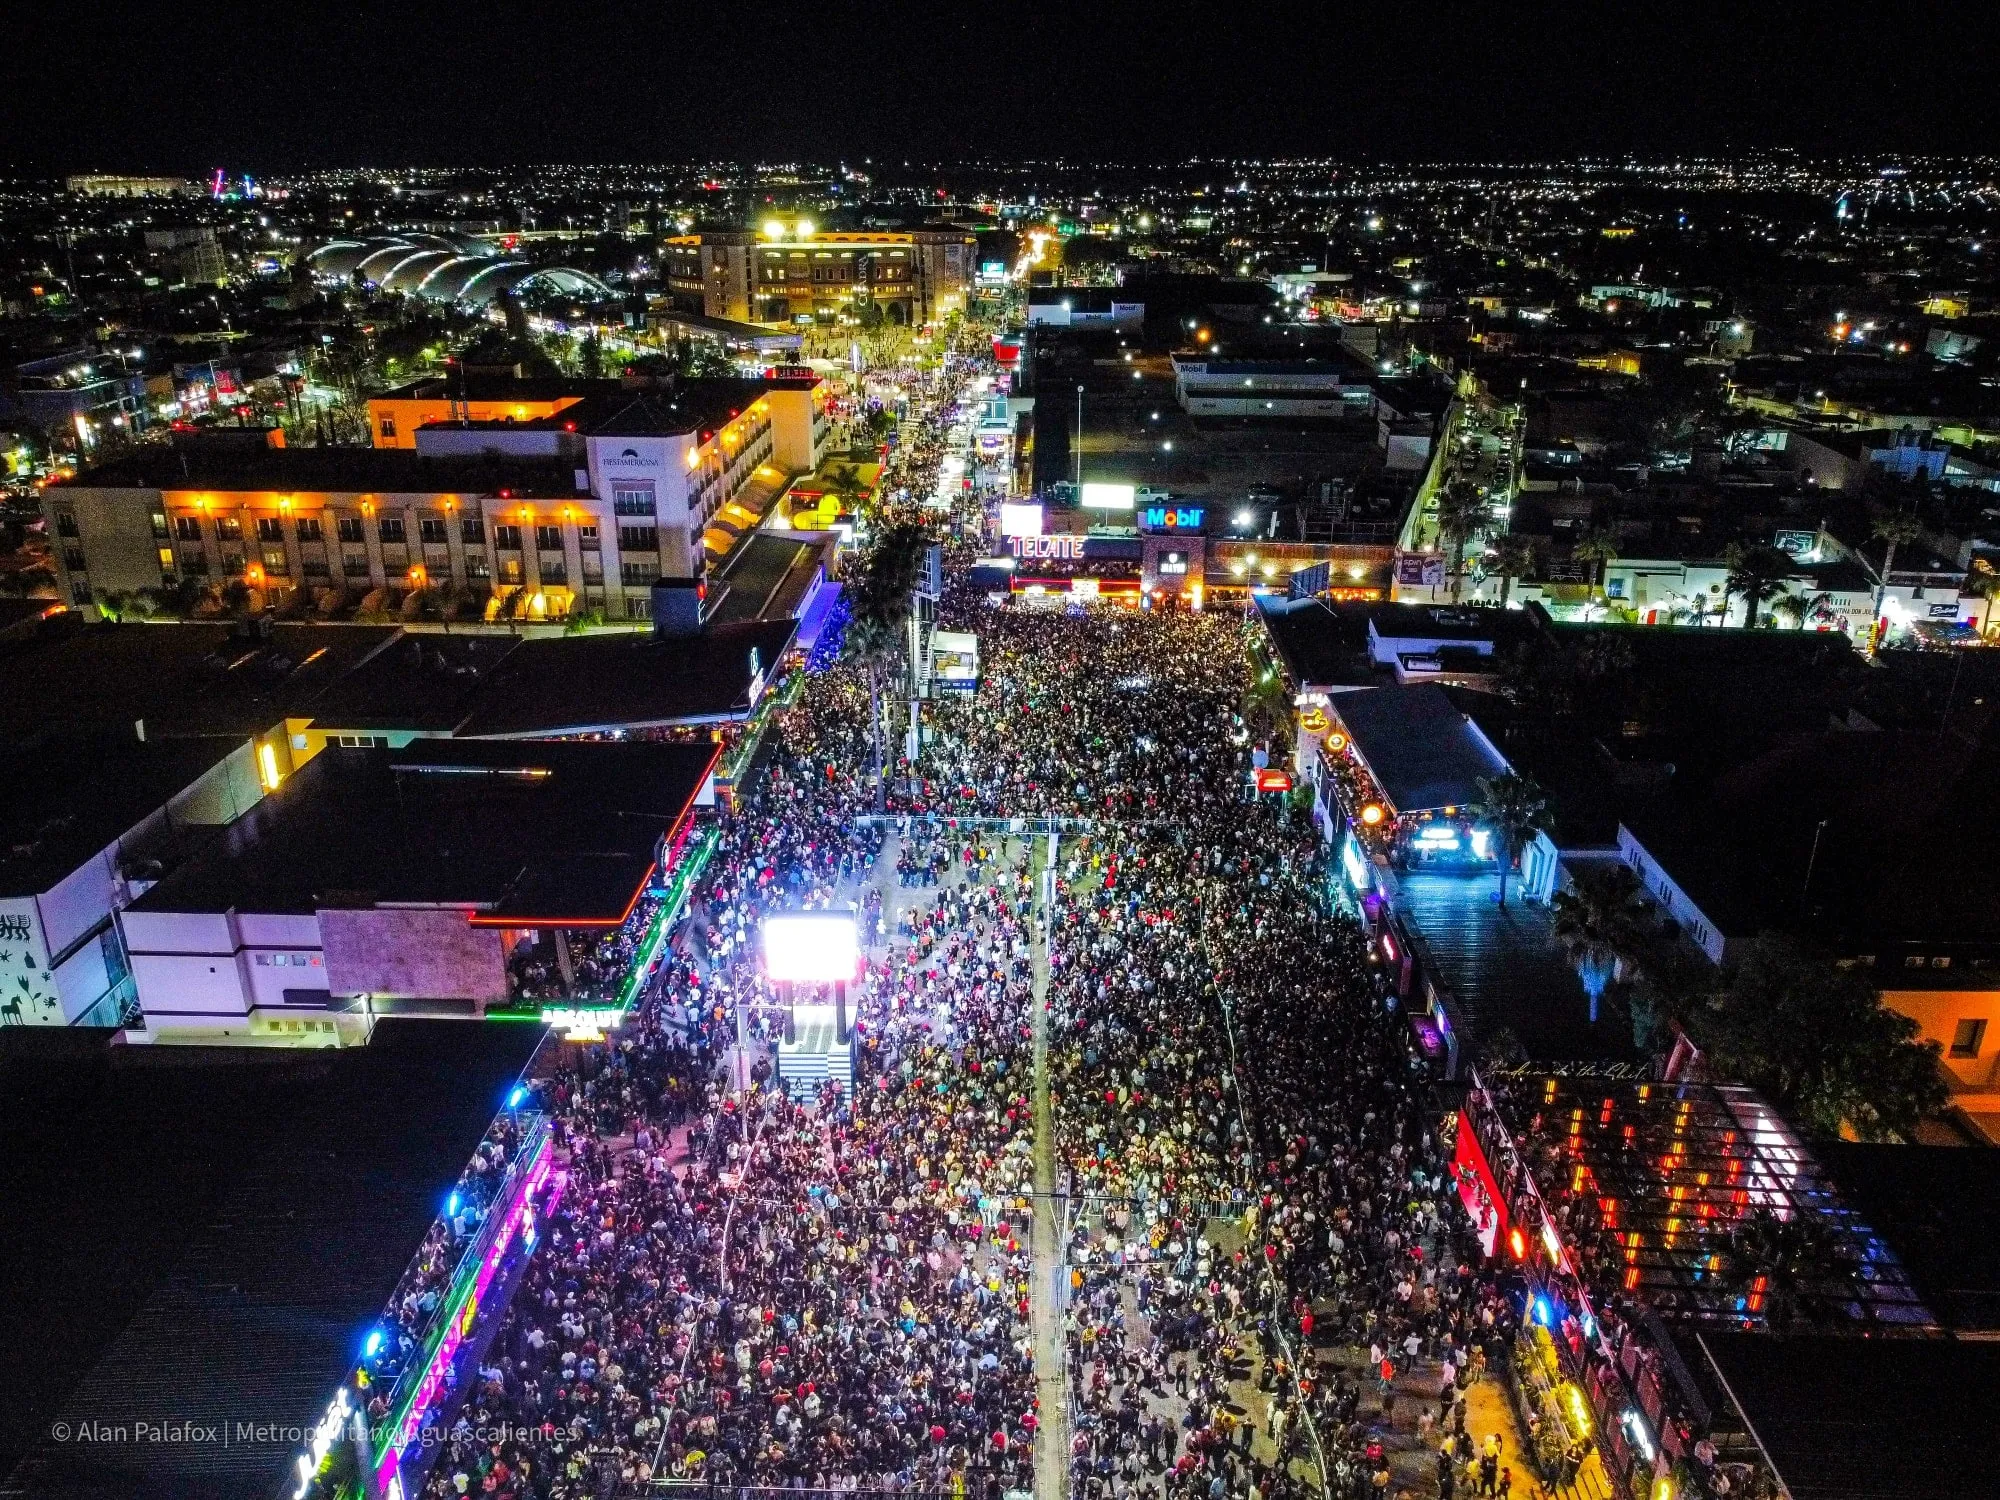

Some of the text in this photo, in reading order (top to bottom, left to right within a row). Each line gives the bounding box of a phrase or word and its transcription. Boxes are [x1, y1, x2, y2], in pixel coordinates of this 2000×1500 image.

[1180, 364, 1203, 373] Mobil
[1146, 508, 1202, 527] Mobil
[1007, 535, 1088, 558] TECATE
